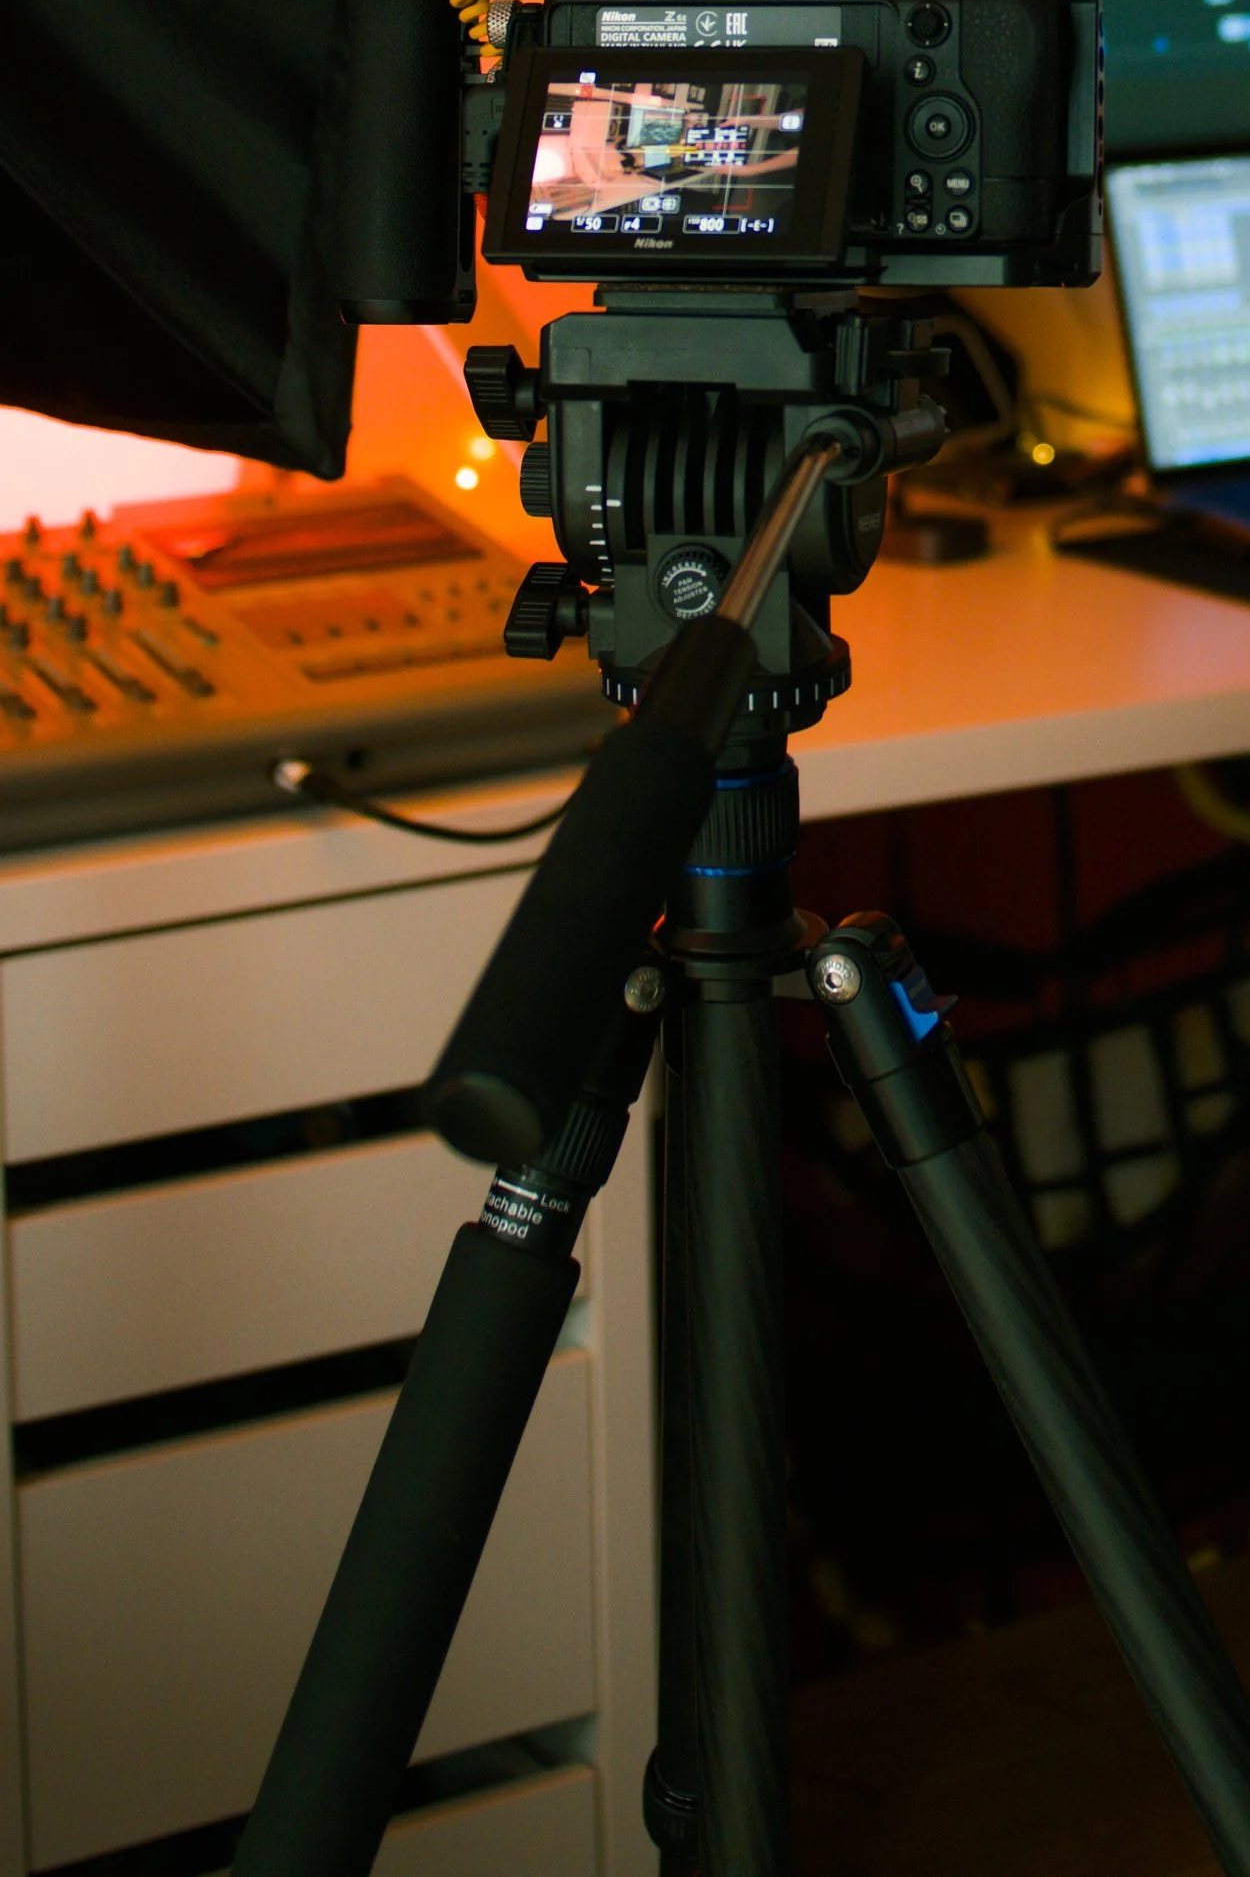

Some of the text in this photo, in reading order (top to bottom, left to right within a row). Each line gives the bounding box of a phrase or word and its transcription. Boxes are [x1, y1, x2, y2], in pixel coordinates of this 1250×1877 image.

[601, 10, 637, 22] Nikon
[600, 32, 687, 42] DIGITAL CAMERA
[929, 122, 945, 132] OK
[946, 178, 970, 189] MENU
[633, 237, 674, 249] Nikon
[661, 561, 703, 586] INCREASE
[673, 580, 703, 595] TENSION
[677, 577, 693, 586] PAN
[487, 1191, 543, 1225] achable
[540, 1193, 571, 1214] Lock
